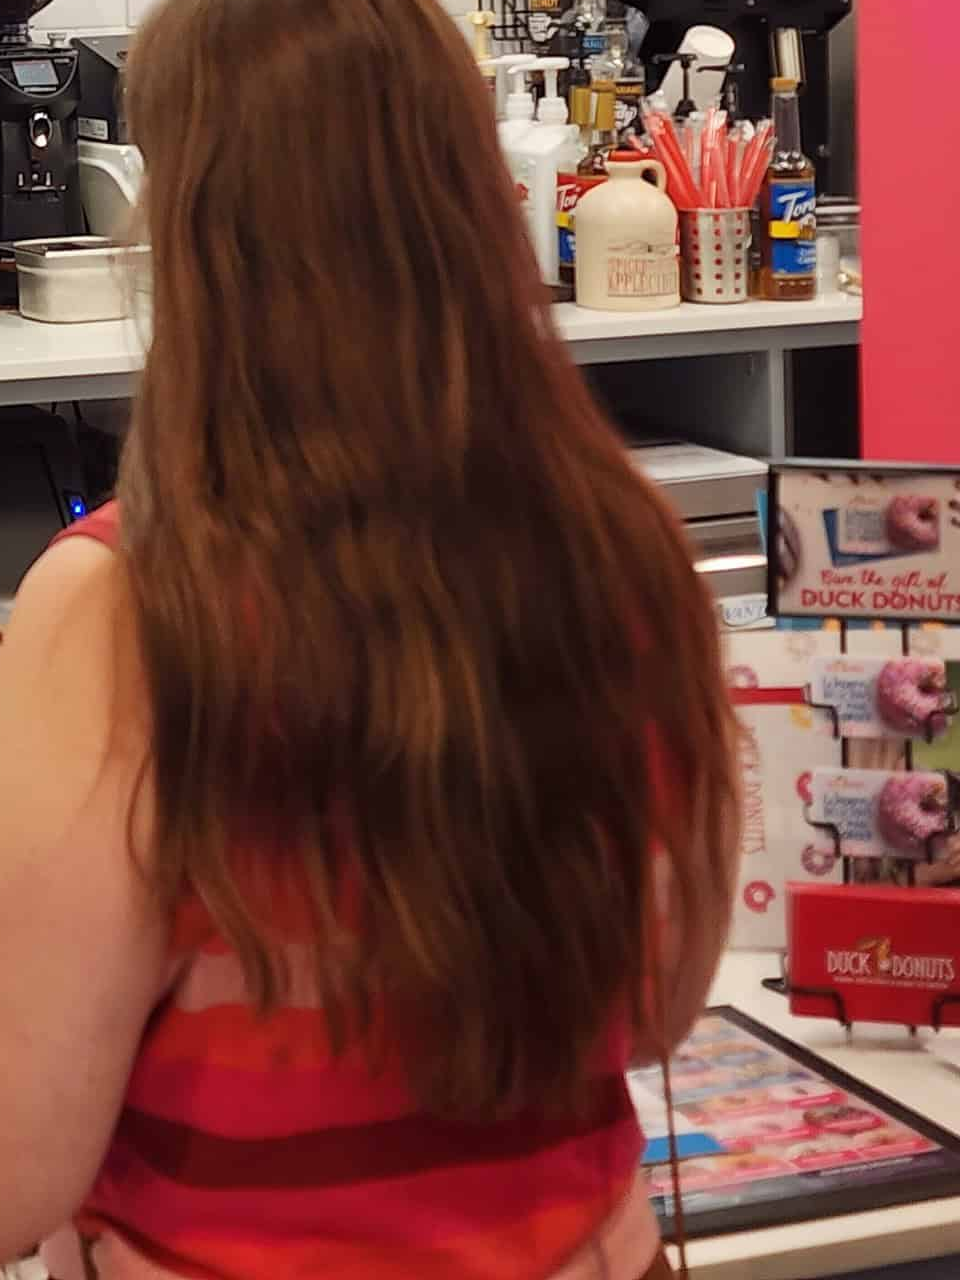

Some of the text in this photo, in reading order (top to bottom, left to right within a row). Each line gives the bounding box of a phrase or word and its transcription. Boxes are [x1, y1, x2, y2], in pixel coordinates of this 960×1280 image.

[820, 569, 948, 593] Give the gift of
[801, 589, 960, 611] DUCK DONUTS
[826, 950, 955, 981] DUCK DONUTS
